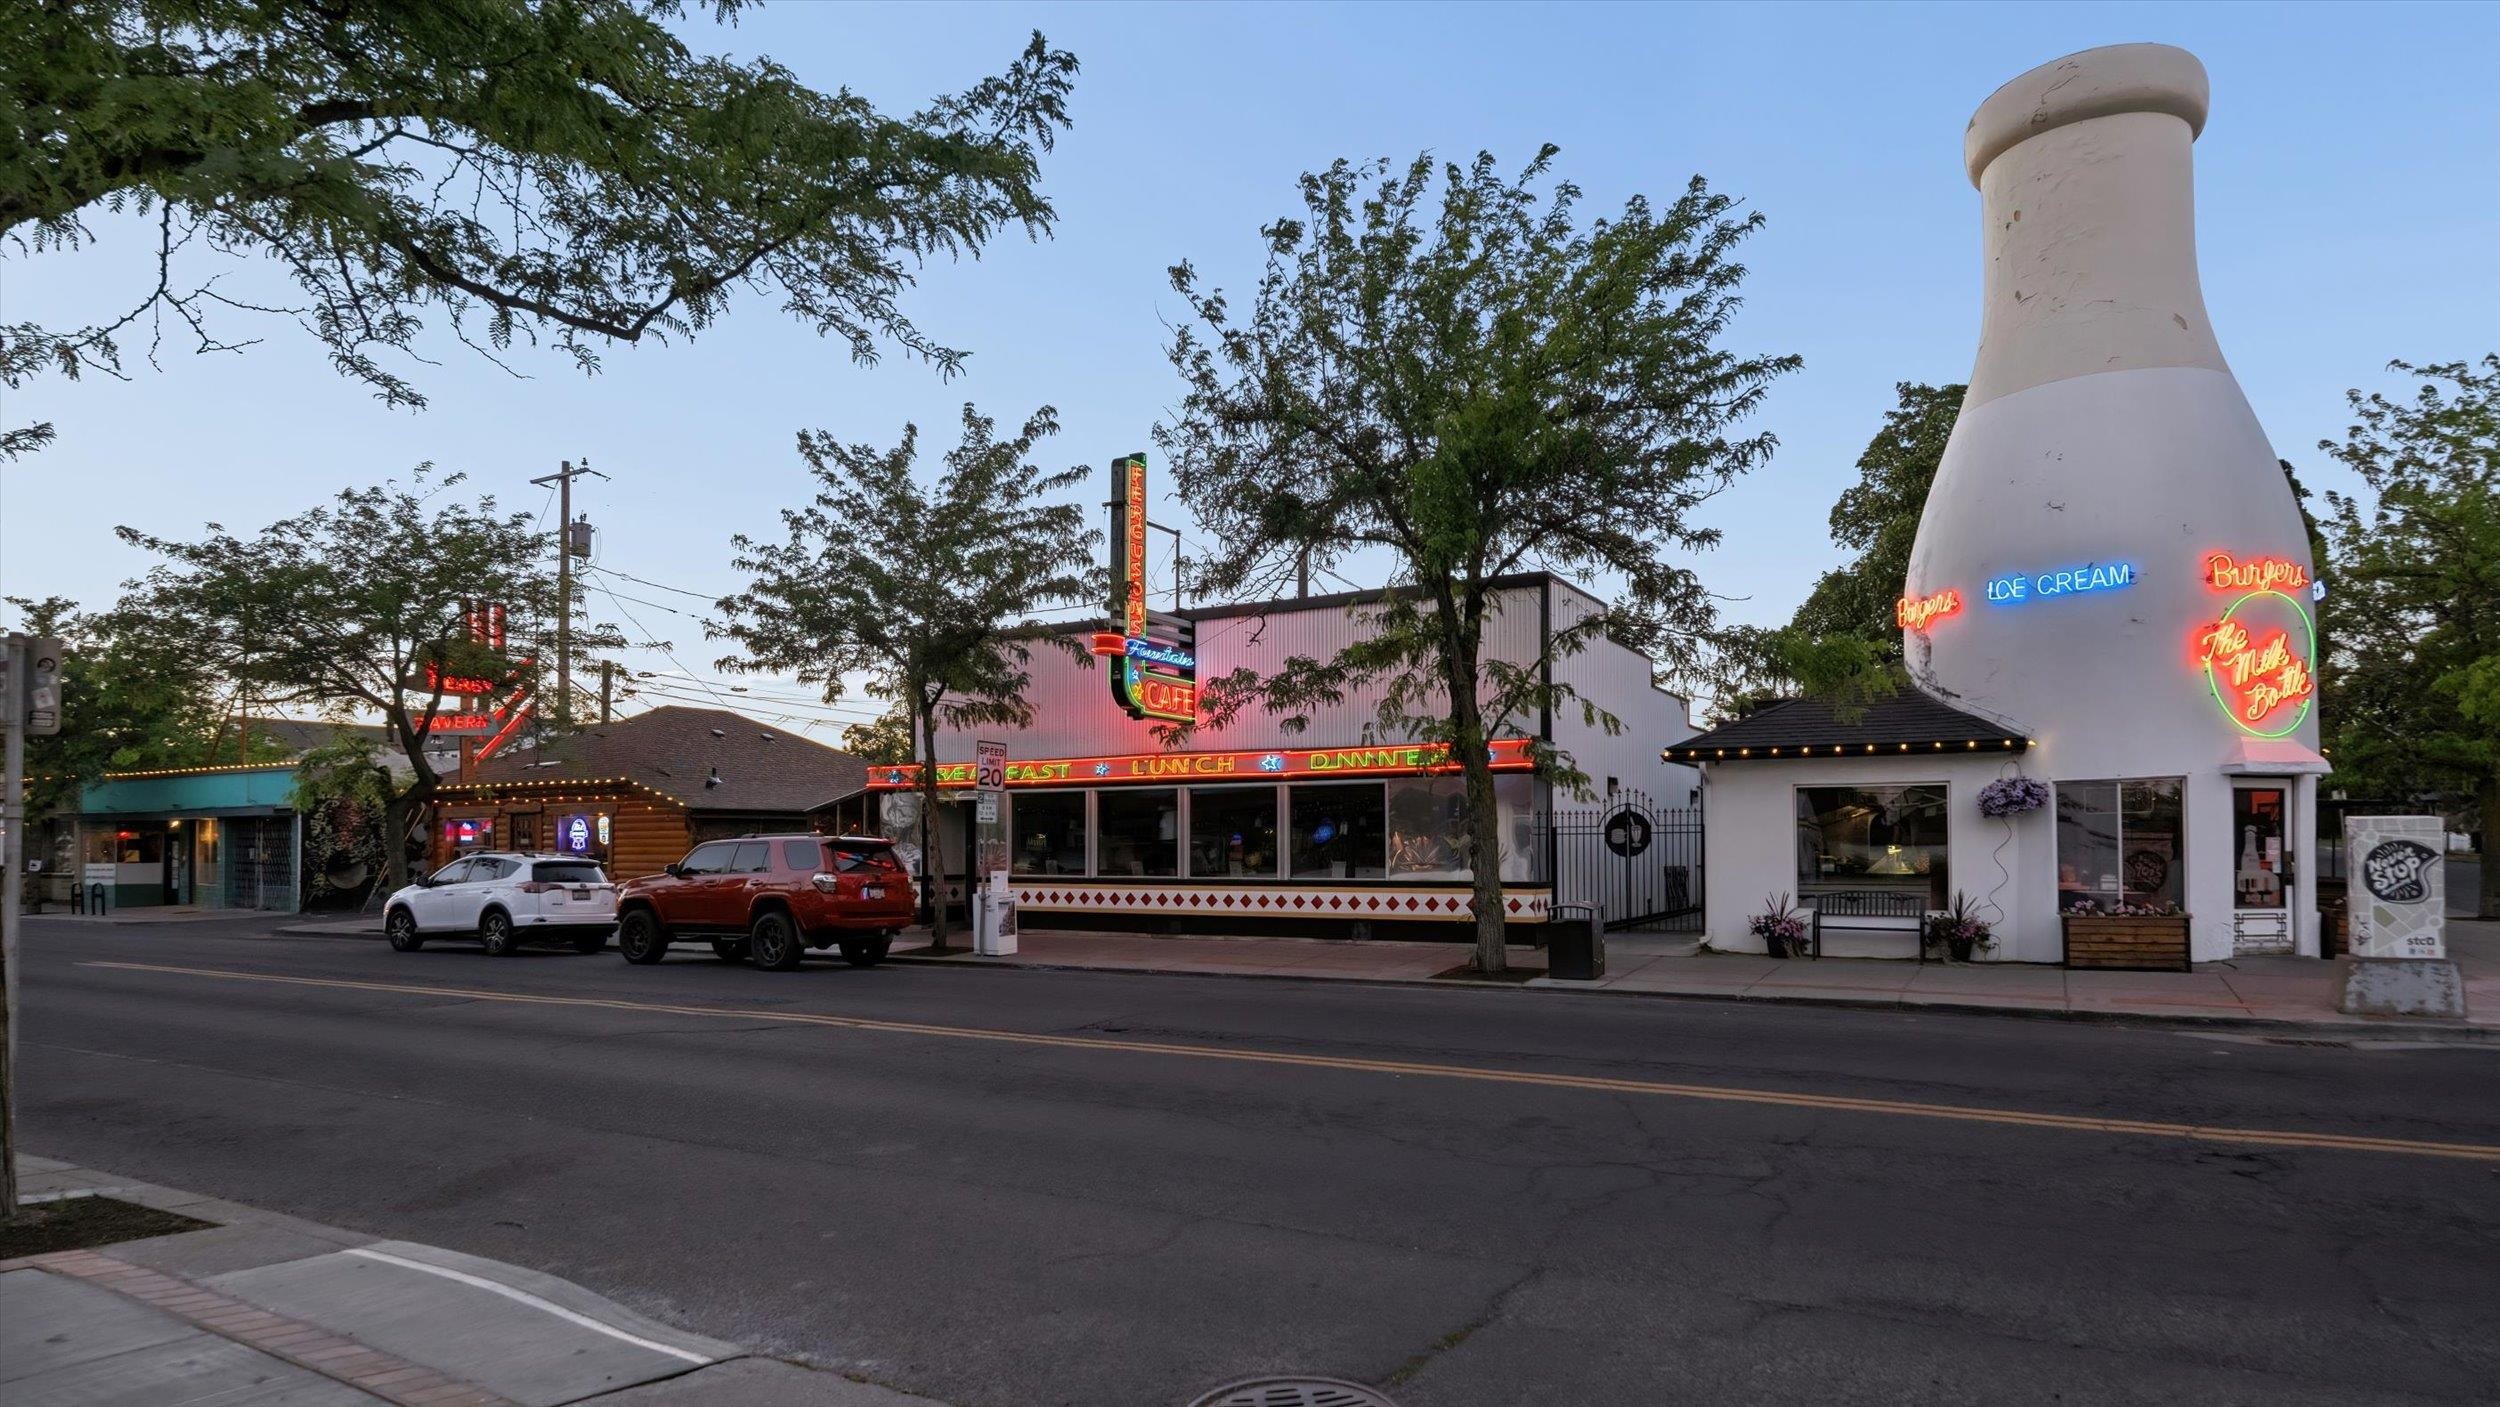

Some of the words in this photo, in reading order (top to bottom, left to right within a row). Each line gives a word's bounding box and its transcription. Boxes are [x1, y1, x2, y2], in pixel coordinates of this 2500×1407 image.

[1987, 576, 2026, 600] ICE
[2037, 563, 2130, 595] CREAM
[2208, 554, 2309, 591] Burgers
[1896, 591, 1958, 628] Burgers
[1125, 638, 1195, 667] Fountain
[2201, 622, 2249, 662] The
[2223, 633, 2290, 686] Milk
[1145, 681, 1194, 714] CAFE
[2245, 660, 2313, 720] Bottle
[979, 746, 1005, 757] SPEED
[981, 757, 1002, 767] LIMIT
[1132, 756, 1236, 775] LUNCH
[921, 763, 1072, 782] REFAST
[978, 767, 1003, 788] 20
[2371, 856, 2422, 891] STOP
